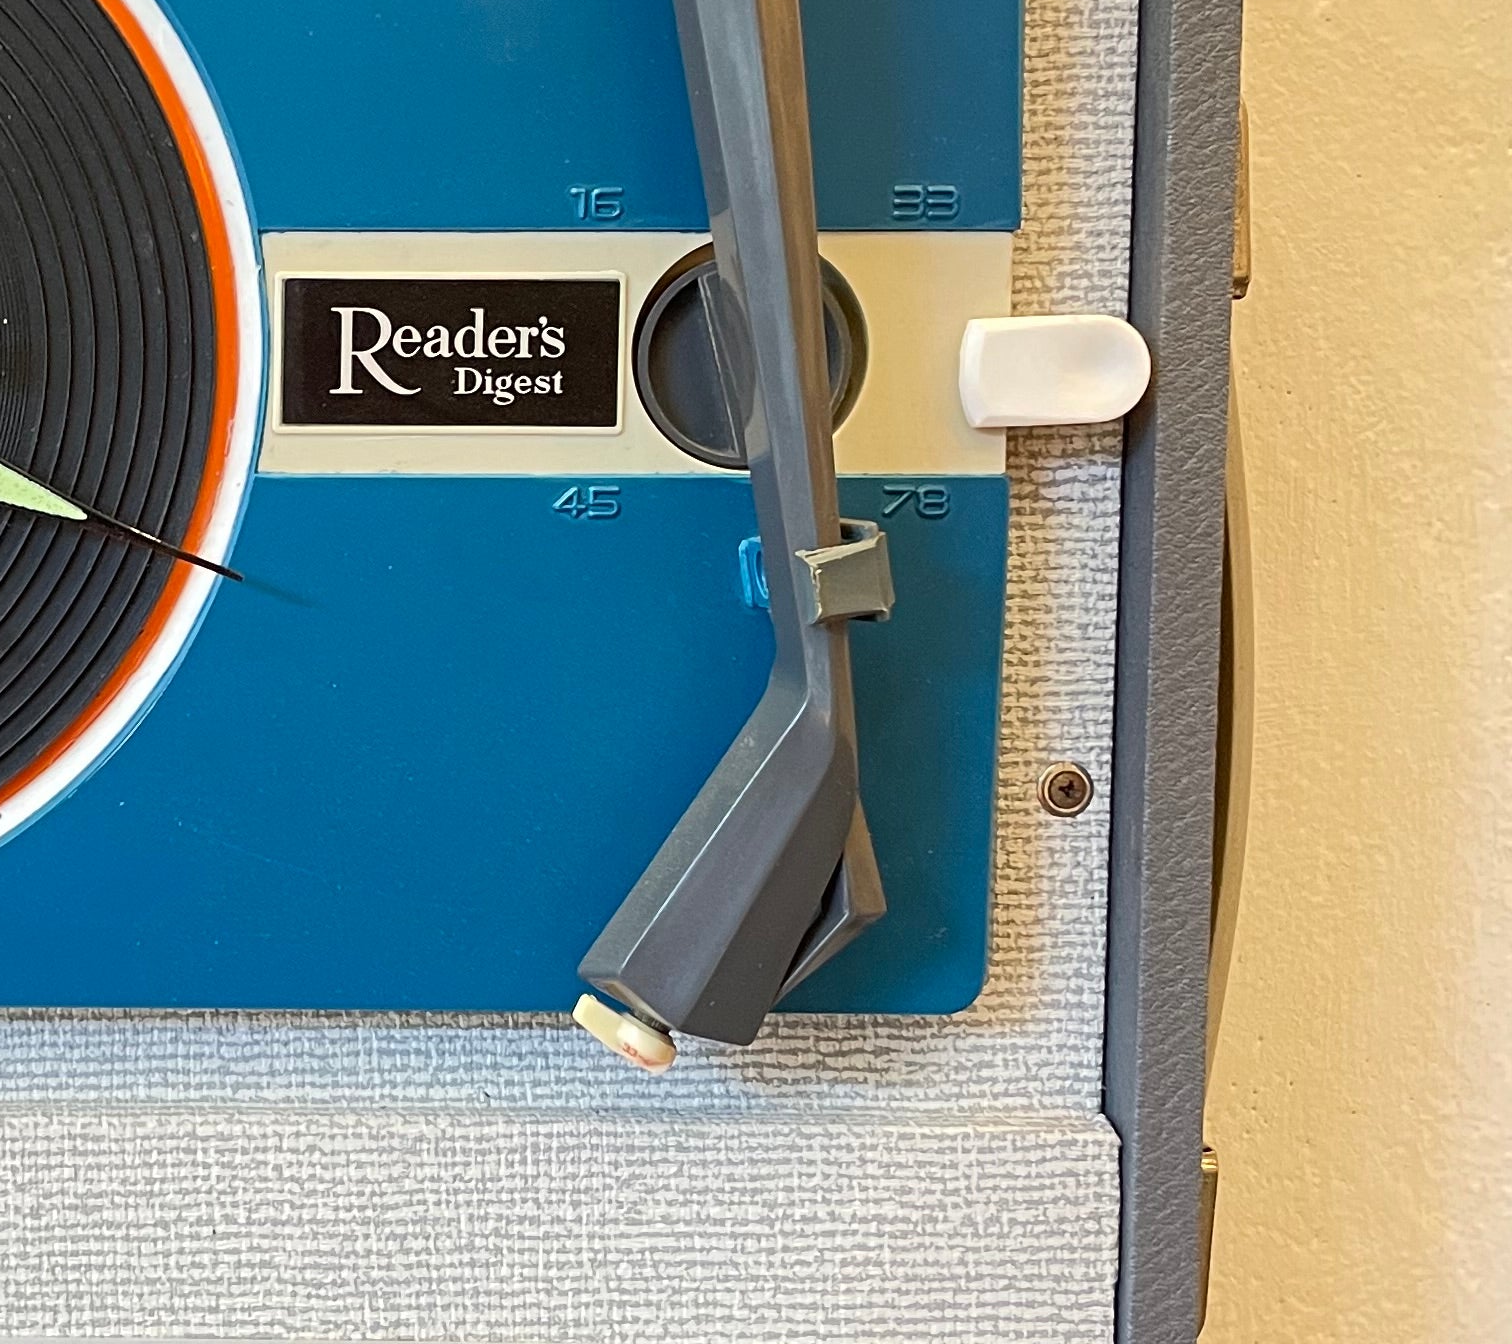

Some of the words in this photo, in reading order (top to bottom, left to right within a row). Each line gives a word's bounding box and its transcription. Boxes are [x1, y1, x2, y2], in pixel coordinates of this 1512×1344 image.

[568, 186, 624, 221] 16
[892, 183, 962, 221] 33
[329, 306, 567, 396] Reader's
[453, 366, 564, 406] Digest
[550, 485, 622, 520] 45
[881, 485, 952, 521] 78
